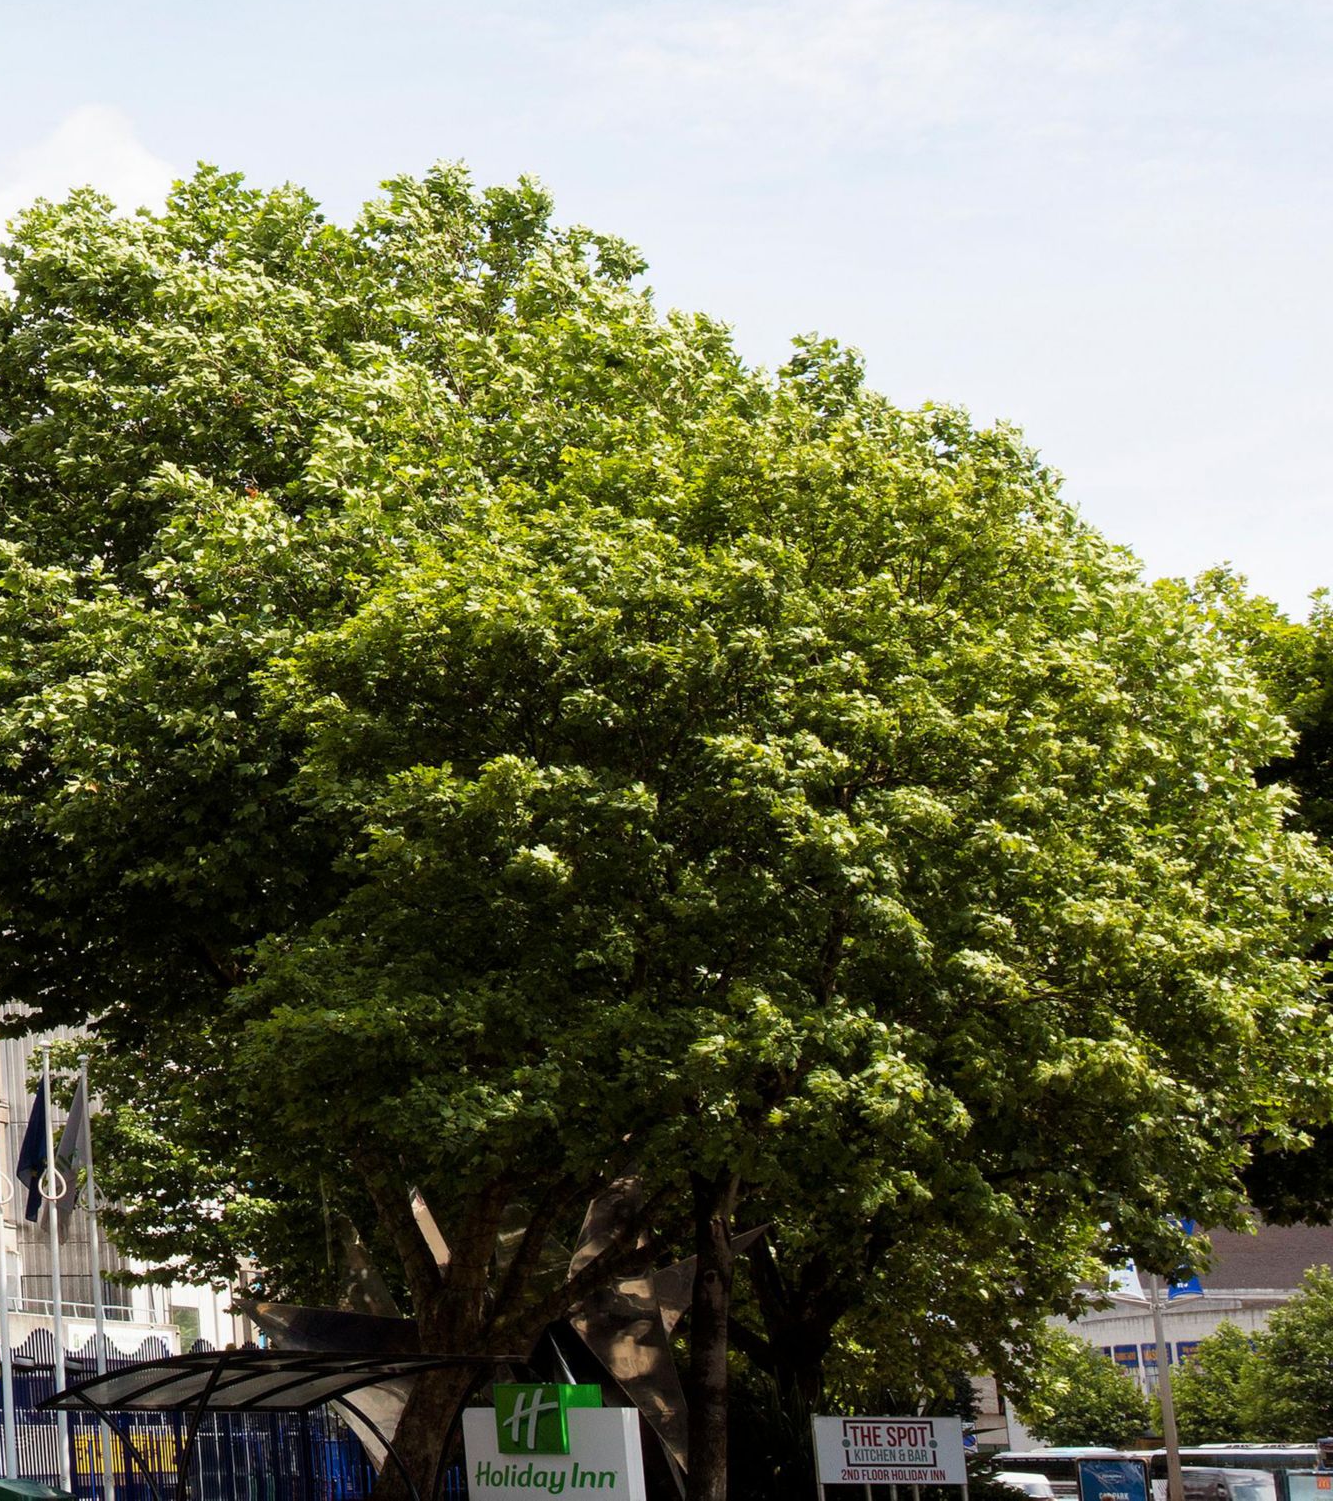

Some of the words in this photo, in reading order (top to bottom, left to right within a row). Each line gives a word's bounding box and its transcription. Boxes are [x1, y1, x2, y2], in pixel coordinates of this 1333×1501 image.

[849, 1426, 882, 1447] THE
[886, 1426, 928, 1448] SPOT
[854, 1449, 897, 1462] KITCHEN
[898, 1450, 906, 1462] &
[908, 1450, 928, 1462] BAR
[475, 1461, 567, 1495] Holiday
[570, 1462, 616, 1489] Inn
[841, 1469, 860, 1481] 2ND
[861, 1469, 890, 1481] FLOOR
[892, 1469, 929, 1482] HOLIDAY
[930, 1470, 946, 1481] INN
